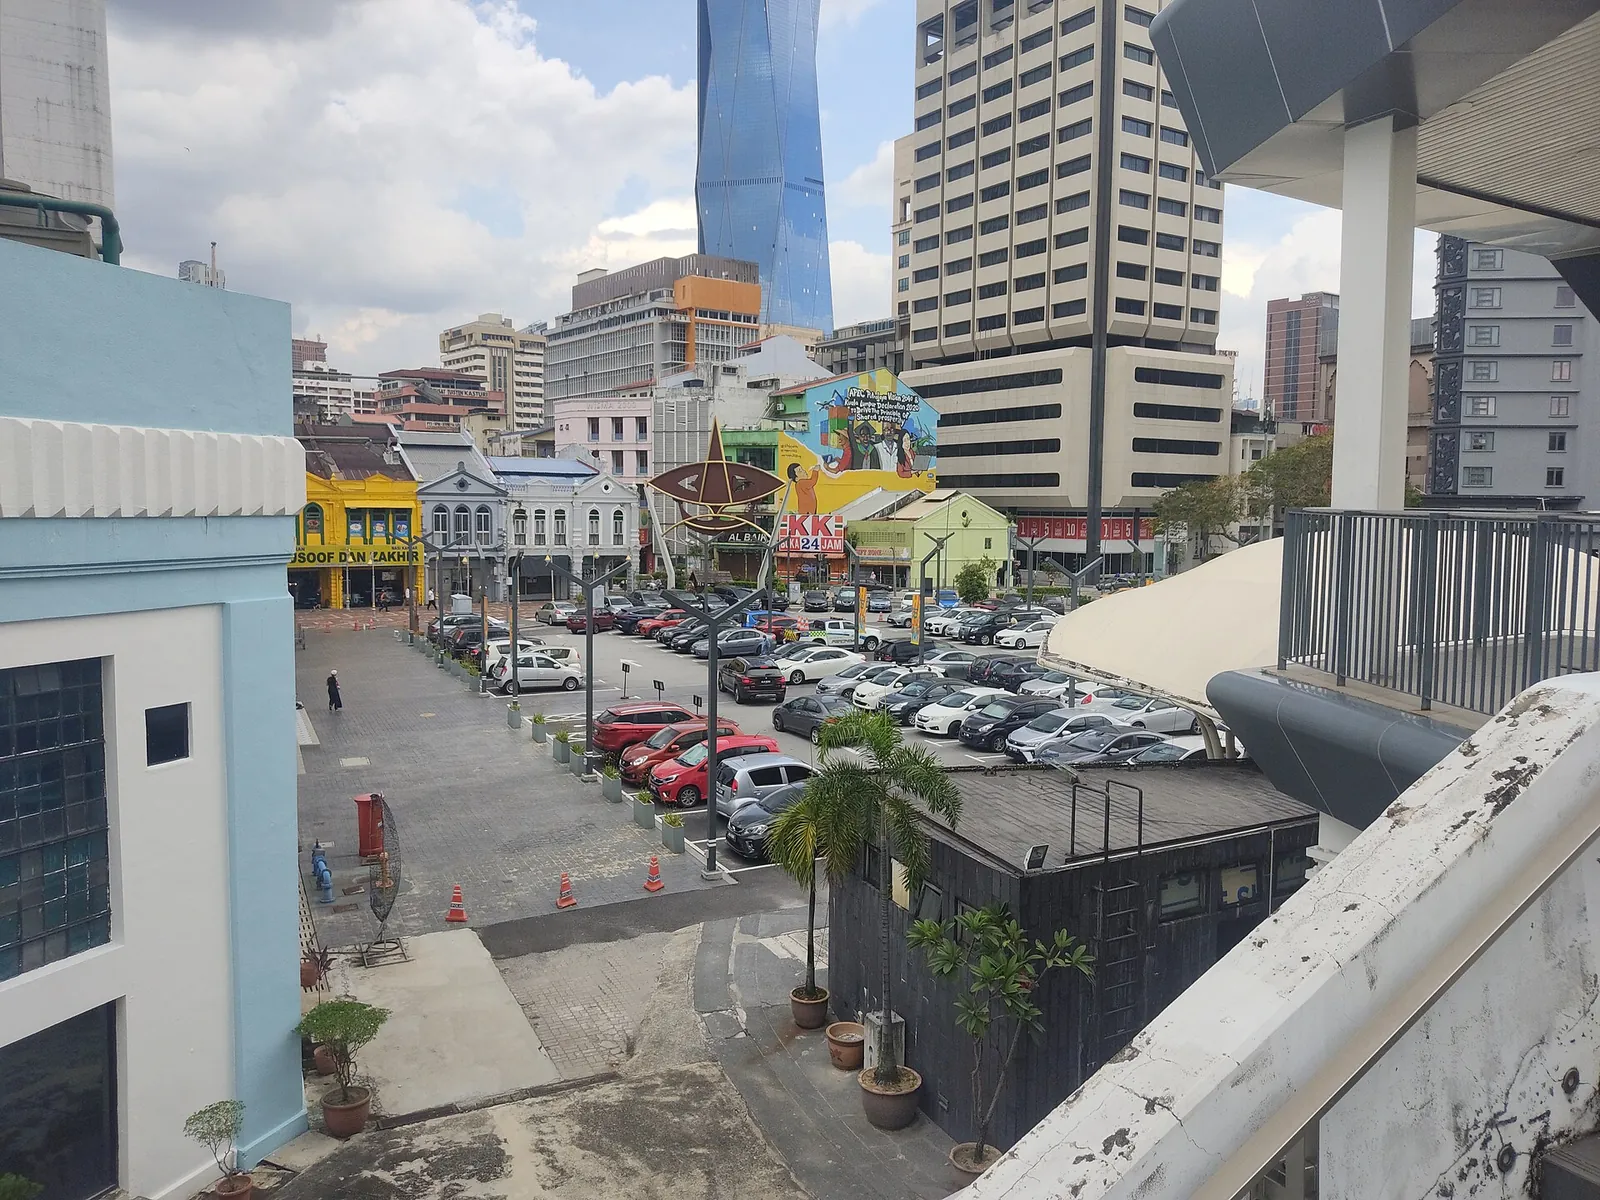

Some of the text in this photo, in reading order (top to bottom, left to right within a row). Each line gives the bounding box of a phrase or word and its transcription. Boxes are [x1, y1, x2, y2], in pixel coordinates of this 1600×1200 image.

[849, 388, 865, 398] APEC
[789, 515, 831, 537] KK
[801, 537, 820, 551] 24
[821, 539, 842, 550] JAM
[338, 551, 366, 563] DAN
[370, 551, 419, 562] ZAKHIR
